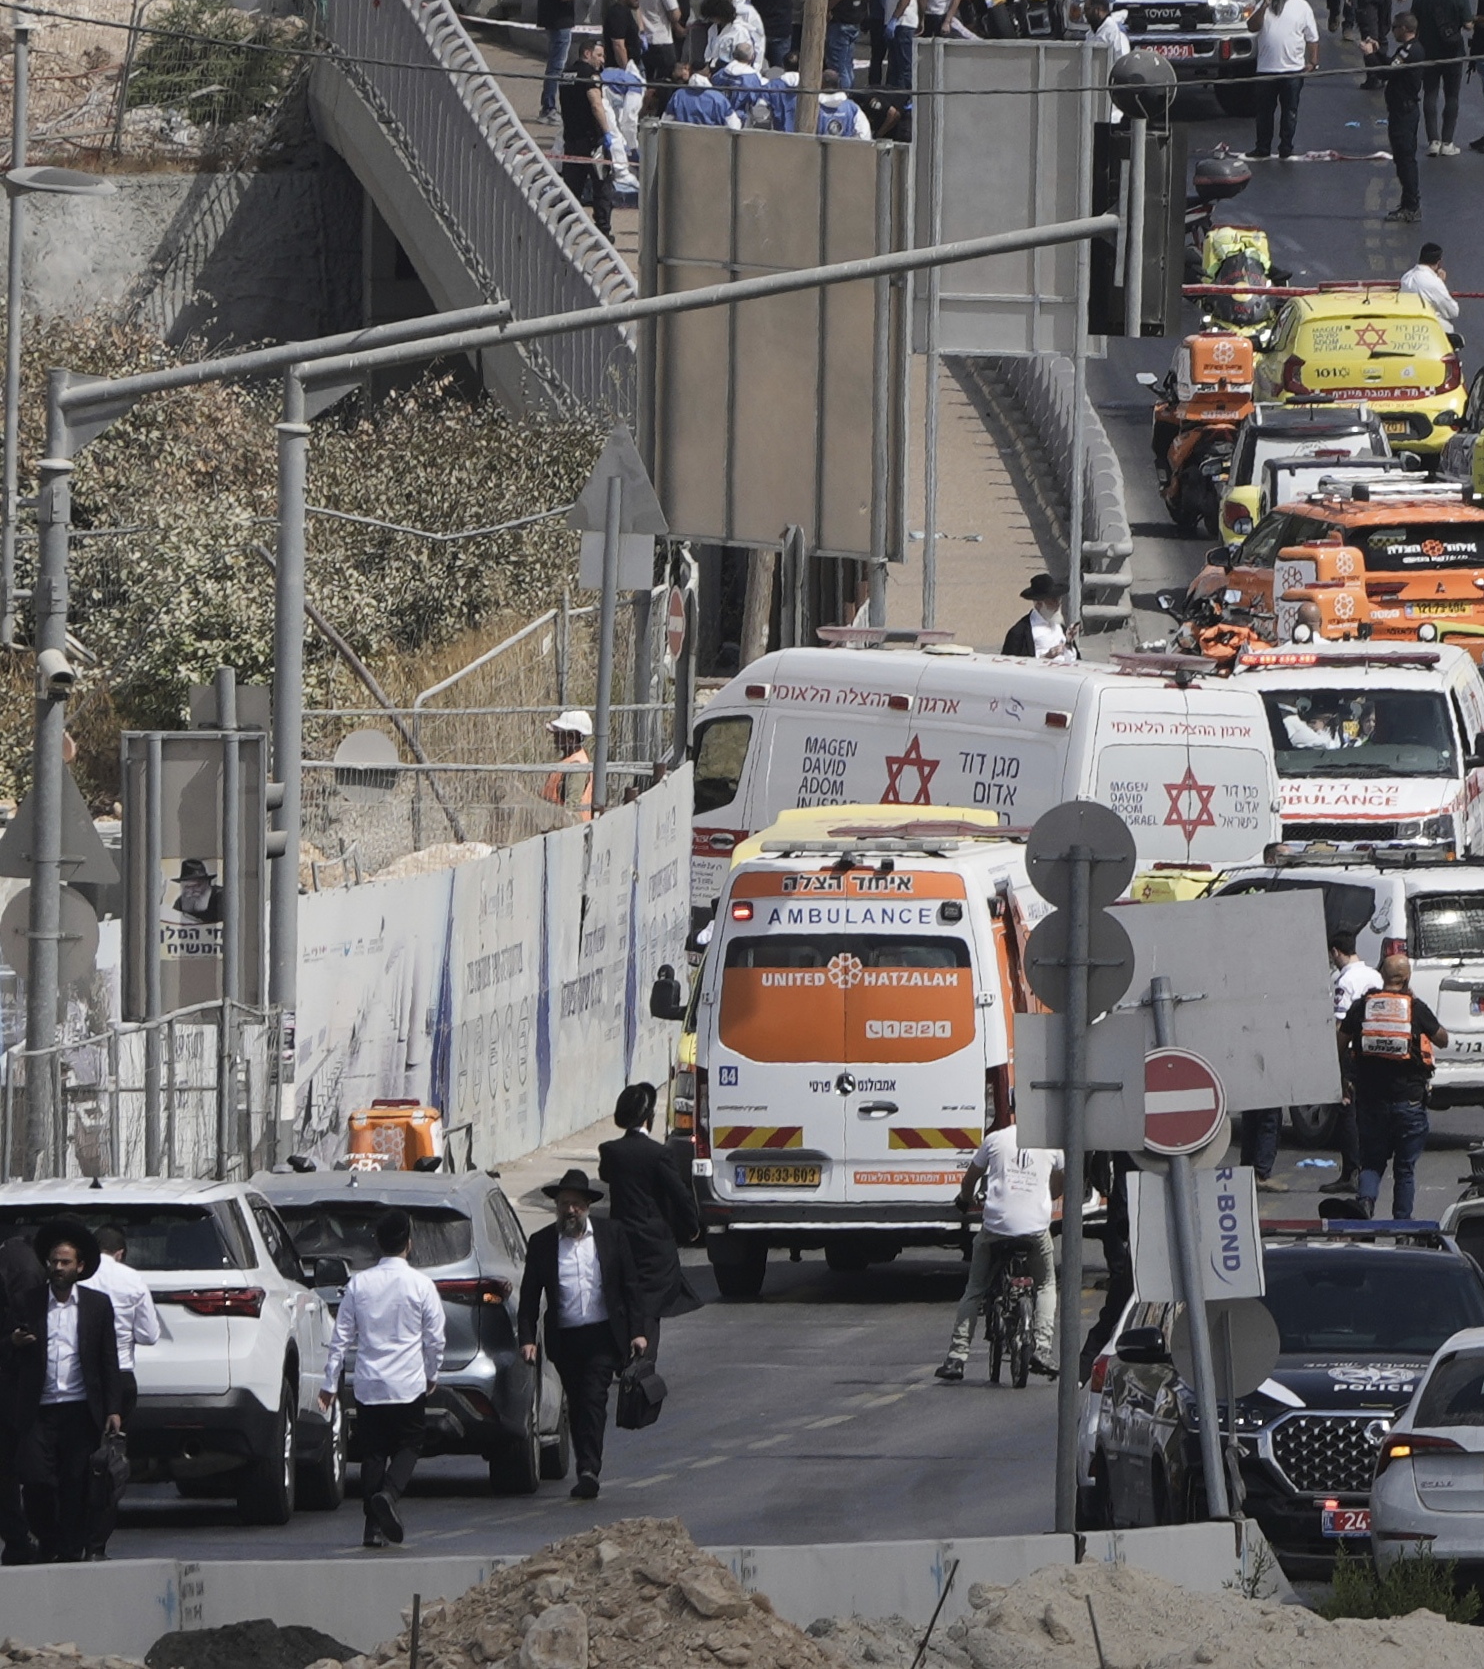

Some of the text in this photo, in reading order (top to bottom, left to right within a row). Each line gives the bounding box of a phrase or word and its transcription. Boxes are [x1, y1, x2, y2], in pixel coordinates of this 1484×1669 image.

[1145, 9, 1182, 19] TOYOTA
[771, 683, 829, 705] הלאומי
[917, 694, 961, 716] ארגון
[1111, 721, 1252, 738] ארגון ההצלה הלאומי
[805, 735, 859, 759] MAGEN
[802, 756, 847, 777] DAVID
[957, 751, 1021, 779] מגן דוד
[798, 776, 845, 796] ADOM
[973, 781, 1017, 807] אדום
[1110, 780, 1149, 792] MAGEN
[1240, 786, 1259, 799] מגן
[1110, 791, 1143, 803] DAVID
[1283, 793, 1400, 806] BULANCE
[1111, 802, 1143, 814] ADOM
[1234, 802, 1260, 813] אדום
[1125, 814, 1158, 826] ISRAEL
[1219, 814, 1259, 830] בישראל
[782, 874, 912, 893] איחוד הצלה
[767, 907, 932, 926] AMBULANCE
[761, 970, 958, 987] UNITED HATZALAH
[886, 1023, 947, 1037] 1221
[720, 1068, 737, 1083] 84
[857, 1079, 897, 1092] אמבולנס
[1216, 1167, 1241, 1272] R-BOND
[1334, 1383, 1414, 1393] POLICE
